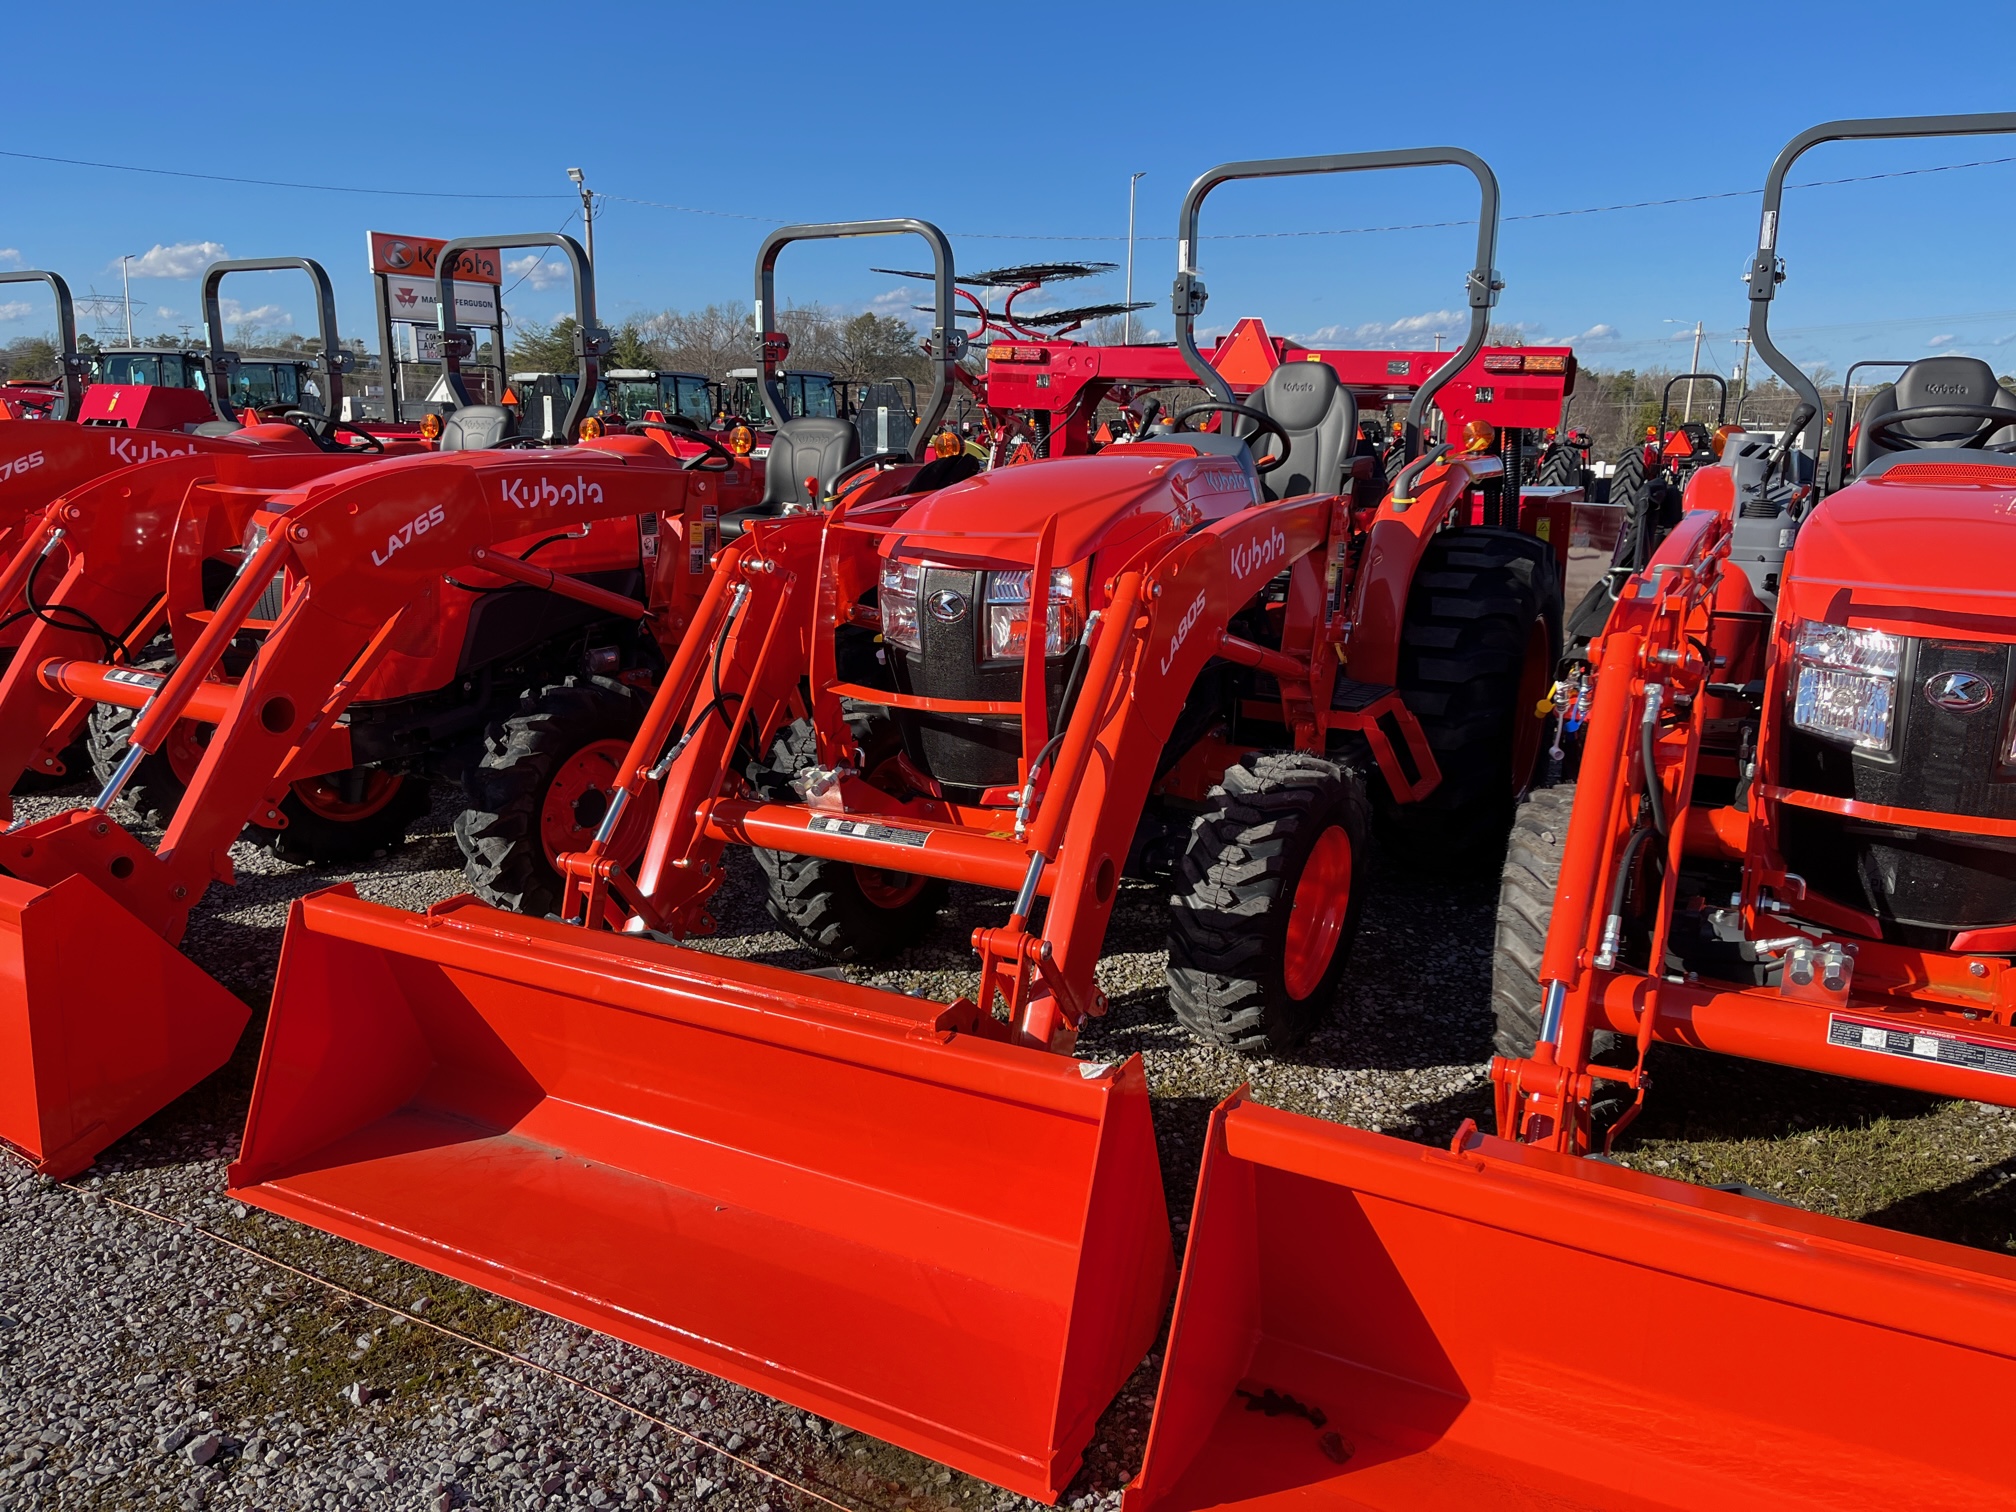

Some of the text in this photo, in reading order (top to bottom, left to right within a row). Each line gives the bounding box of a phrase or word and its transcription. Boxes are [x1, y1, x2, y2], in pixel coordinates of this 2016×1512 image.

[418, 245, 496, 276] Kota
[455, 298, 493, 308] FERGUSON
[1925, 383, 1968, 395] Kubota
[0, 450, 45, 483] 765
[1203, 469, 1248, 492] Kubota
[501, 475, 604, 509] Kubota
[371, 504, 445, 567] LA765
[1230, 526, 1285, 580] Kubota
[1160, 588, 1206, 676] LA805
